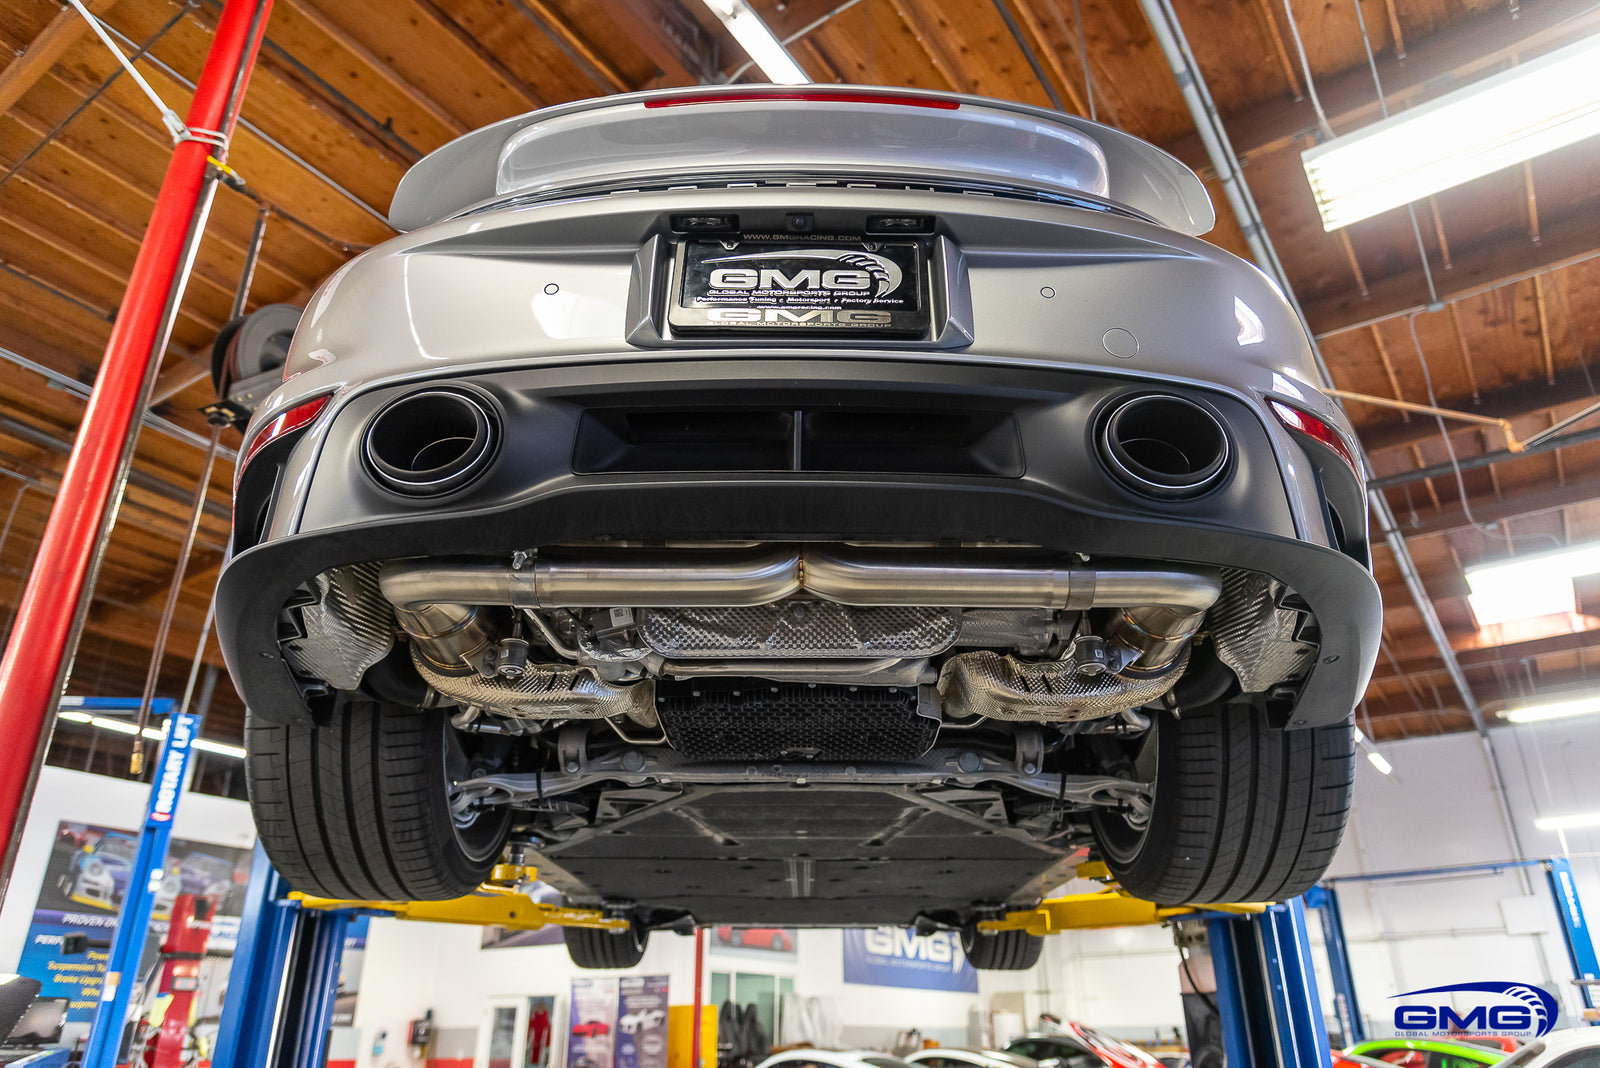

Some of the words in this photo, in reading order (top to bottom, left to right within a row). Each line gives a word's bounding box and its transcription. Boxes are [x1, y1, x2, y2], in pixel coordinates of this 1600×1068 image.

[743, 233, 862, 241] WWW.GMGRACING.COM
[708, 268, 871, 290] GMG
[695, 296, 749, 304] Performance
[749, 296, 777, 305] Tuning
[786, 297, 831, 305] Motorsport
[840, 297, 873, 305] Factory
[707, 289, 750, 297] GLOBAL
[751, 289, 831, 297] MOTORSPORTS
[707, 308, 892, 324] GMG
[154, 749, 186, 813] ROTARY
[171, 714, 194, 749] LIFT
[864, 926, 952, 963] GMG
